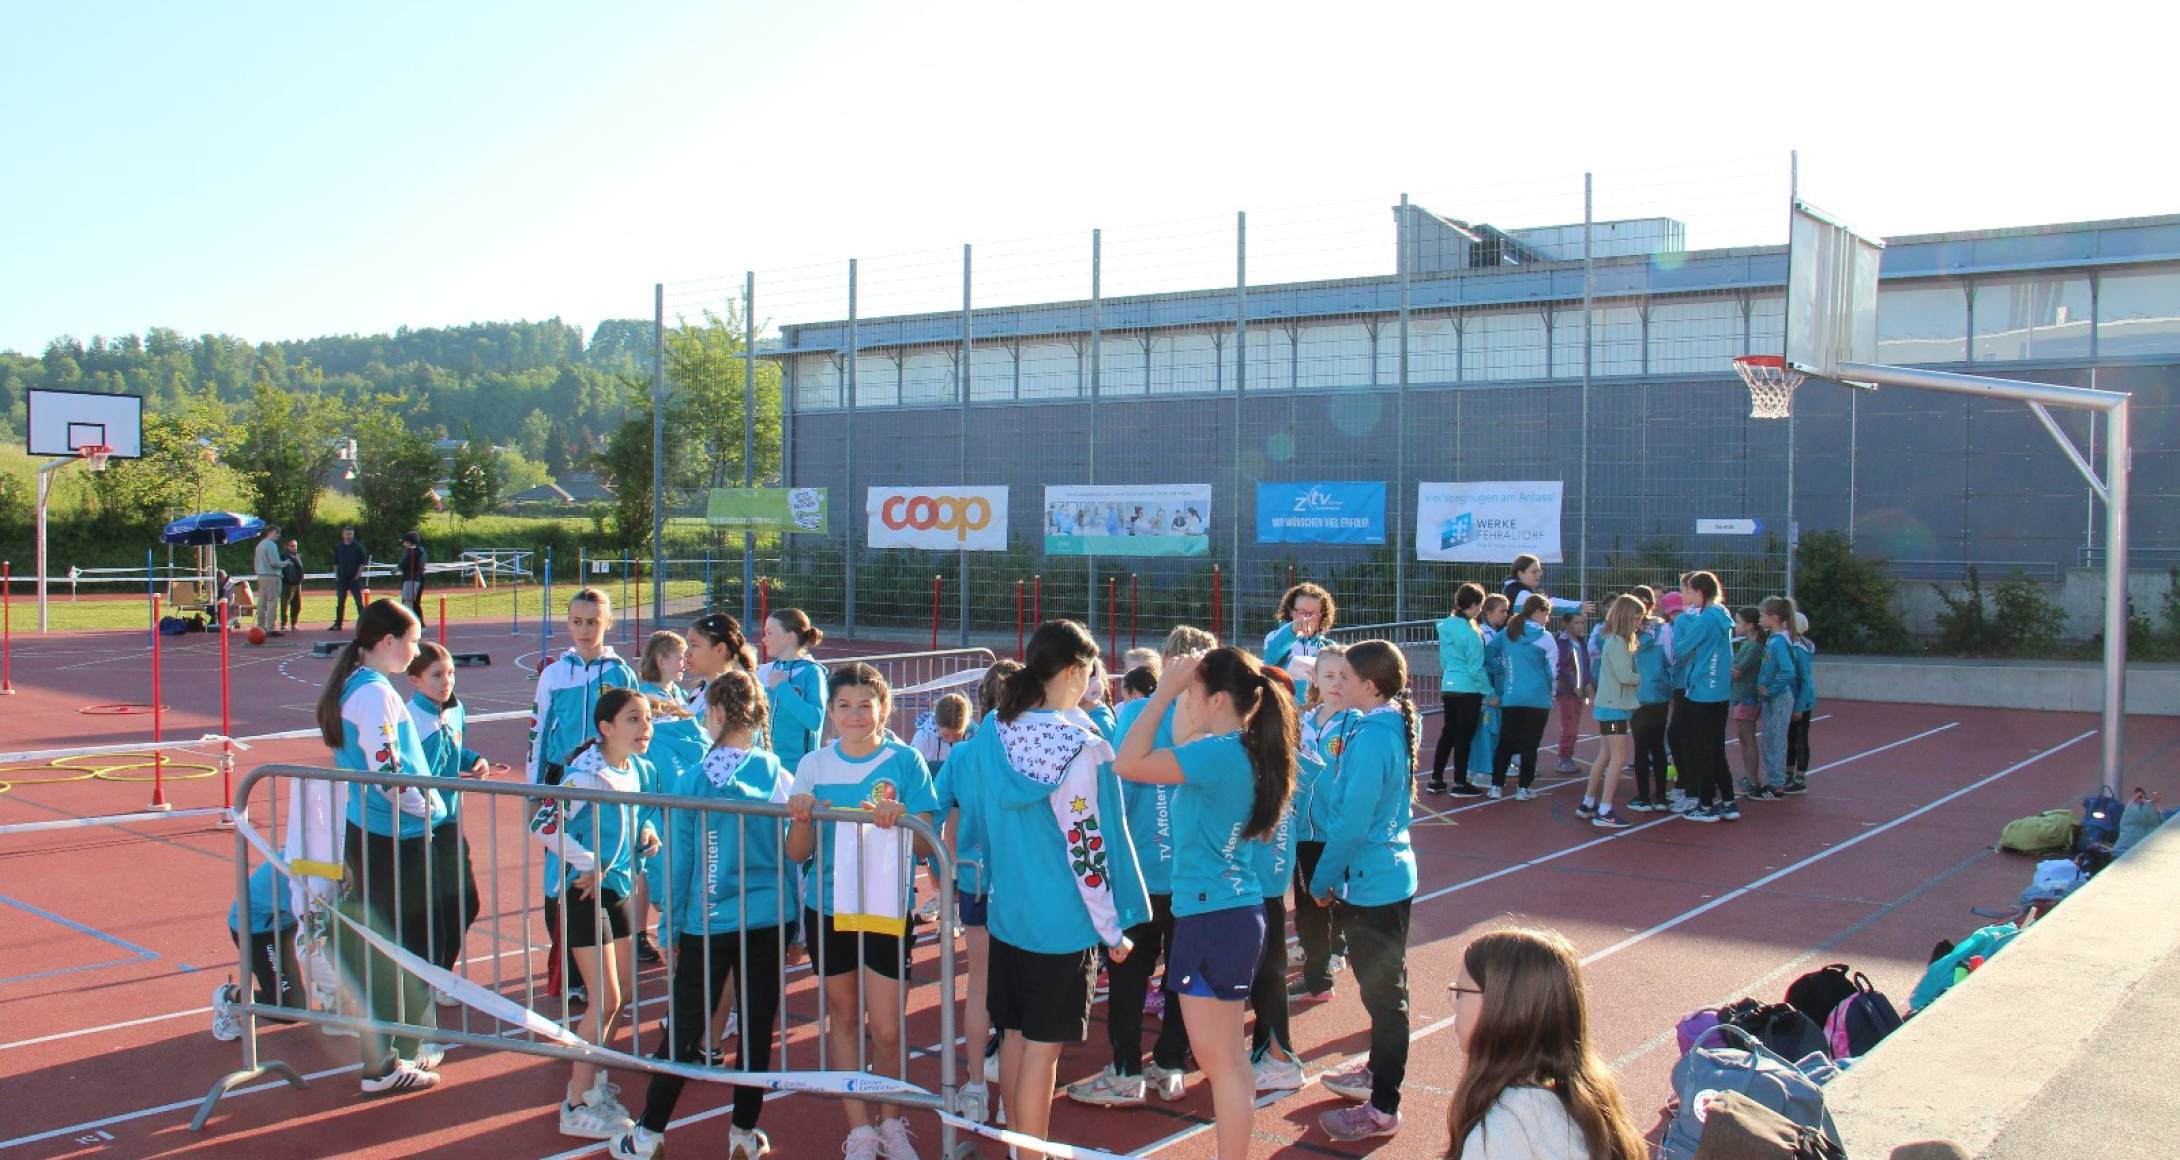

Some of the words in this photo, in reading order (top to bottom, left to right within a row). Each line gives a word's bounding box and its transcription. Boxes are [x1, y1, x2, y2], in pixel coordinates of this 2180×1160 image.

[881, 495, 991, 541] coop
[1476, 518, 1517, 529] WERKE
[1160, 844, 1172, 862] TV
[1274, 857, 1286, 875] TV
[1230, 877, 1245, 895] TV
